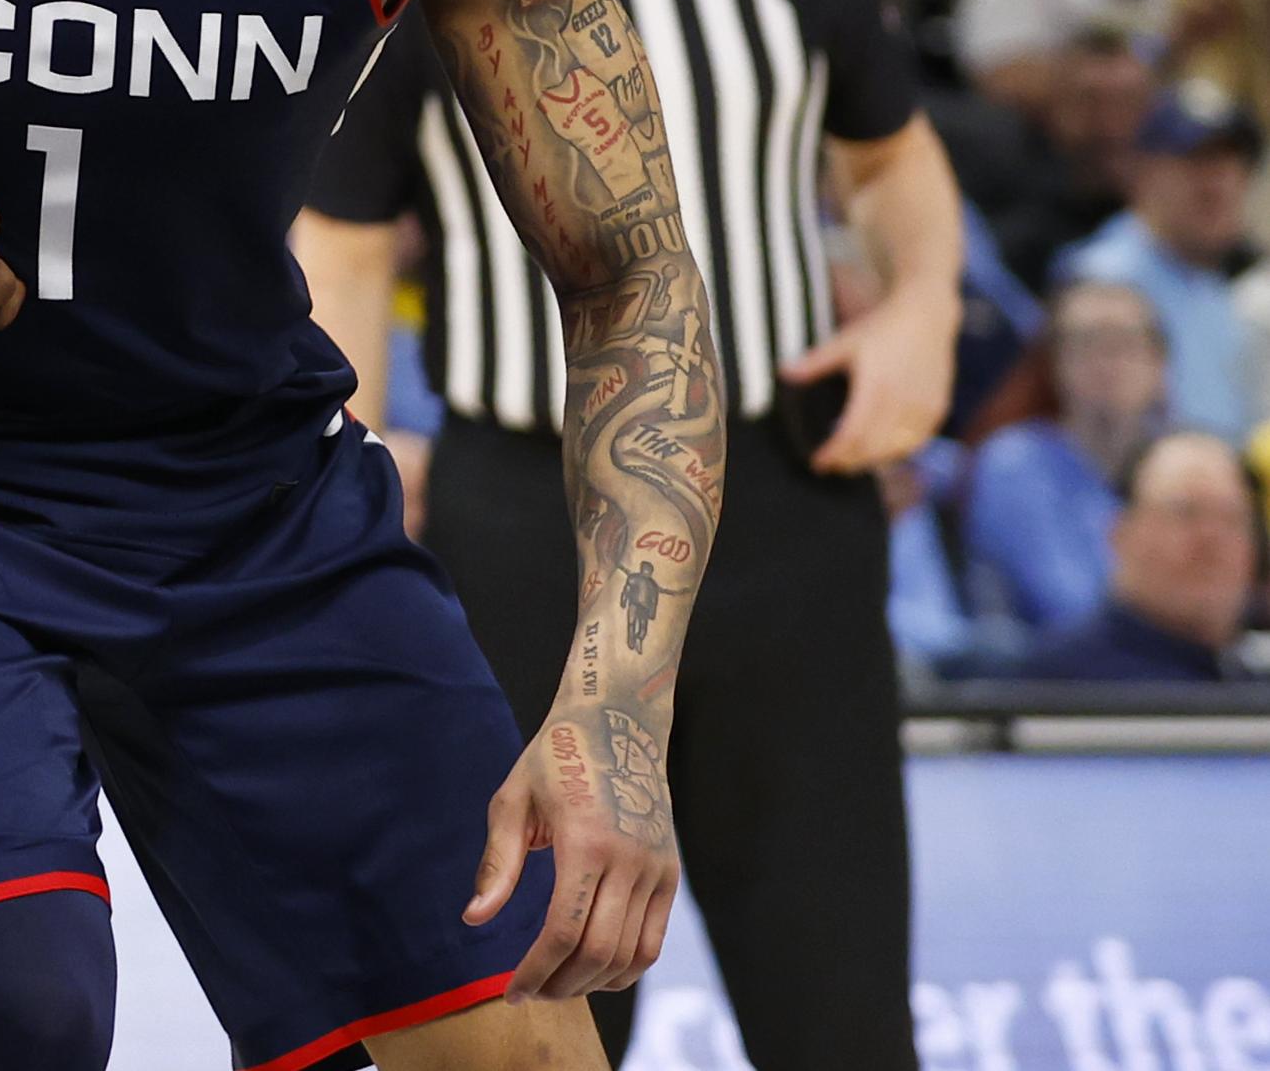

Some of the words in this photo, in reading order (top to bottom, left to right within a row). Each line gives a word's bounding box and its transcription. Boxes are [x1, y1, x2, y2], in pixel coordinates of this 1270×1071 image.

[582, 107, 611, 137] 5
[25, 124, 83, 301] 1
[636, 531, 691, 563] GOD
